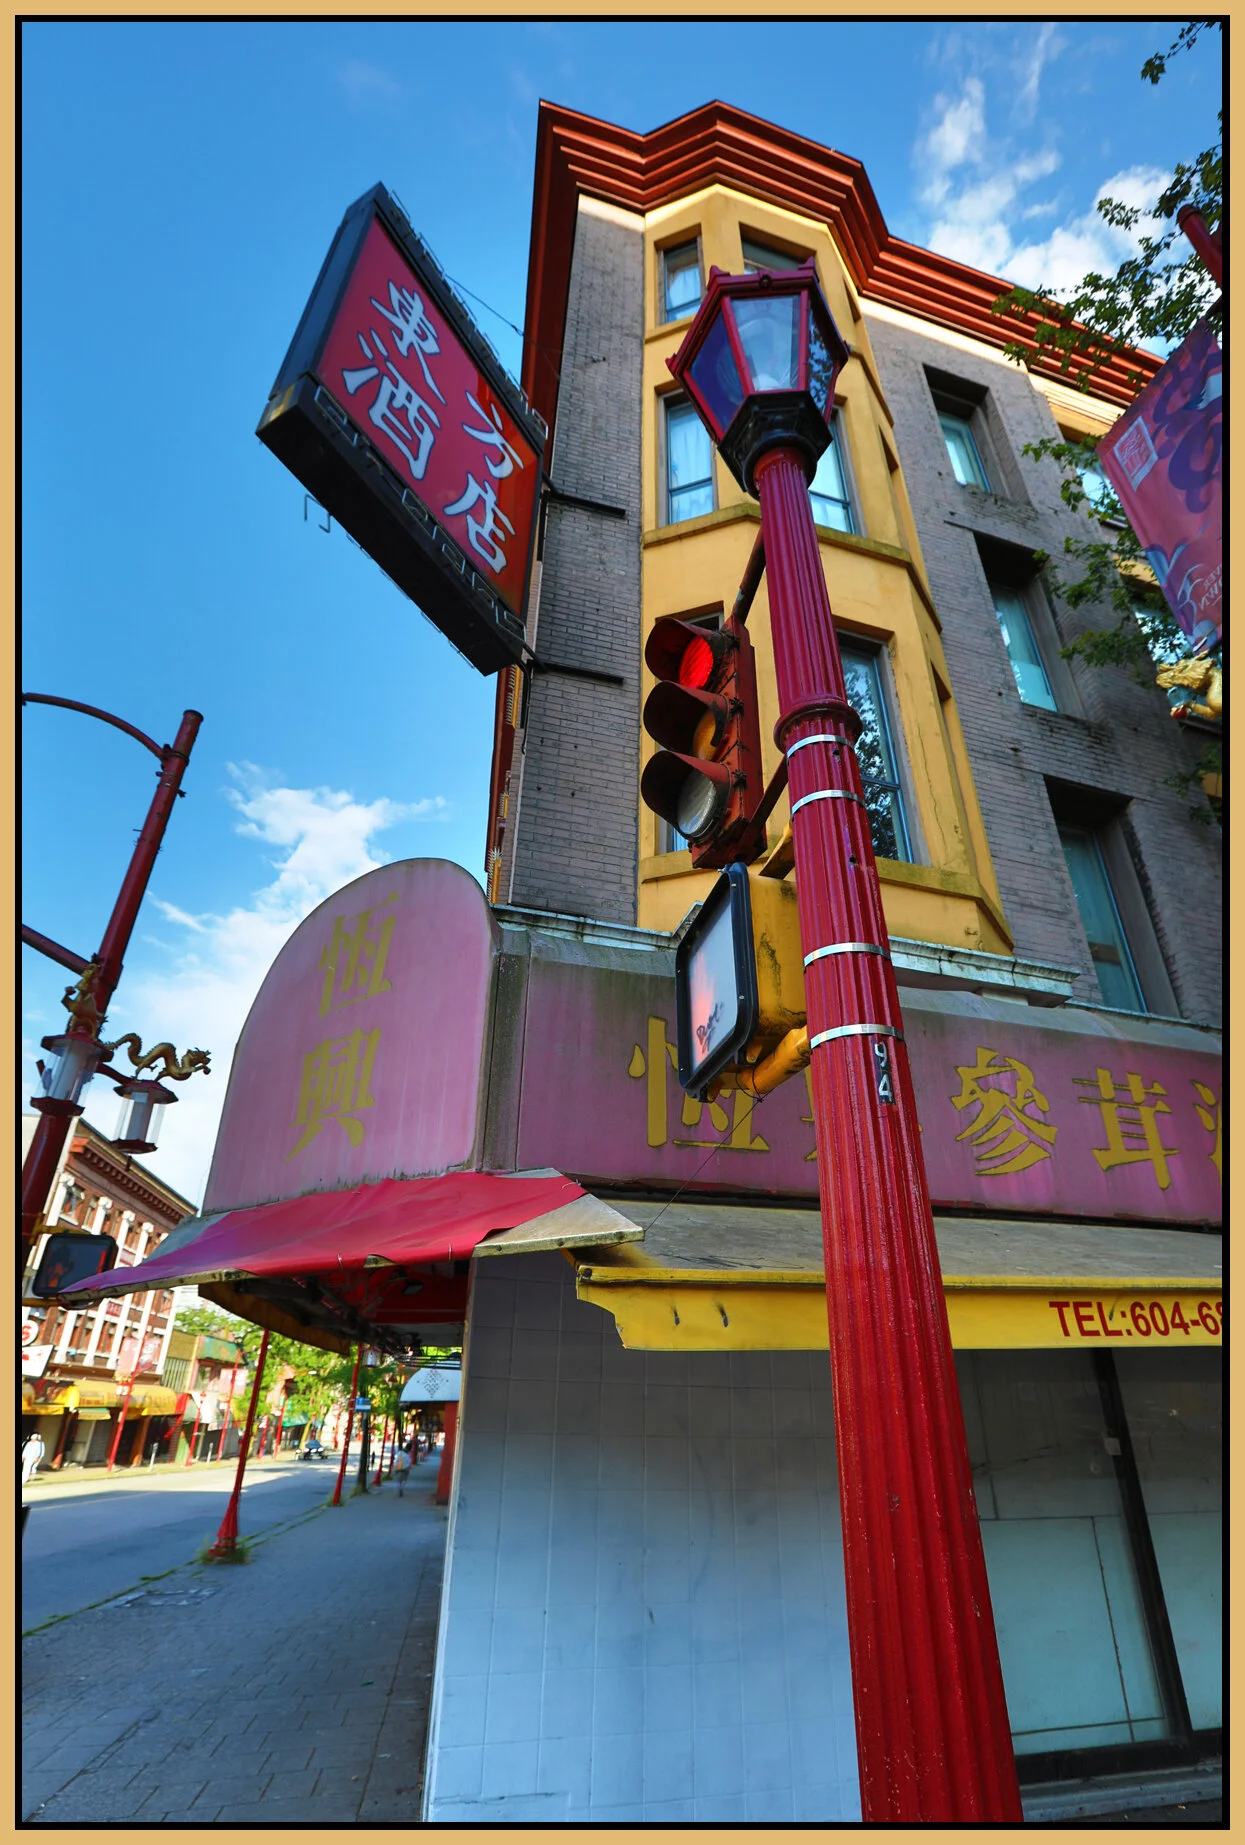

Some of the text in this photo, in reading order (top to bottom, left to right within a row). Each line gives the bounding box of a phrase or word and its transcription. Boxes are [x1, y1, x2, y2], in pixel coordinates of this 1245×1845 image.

[628, 1014, 1222, 1191] 恆參茸
[874, 1040, 893, 1102] 94
